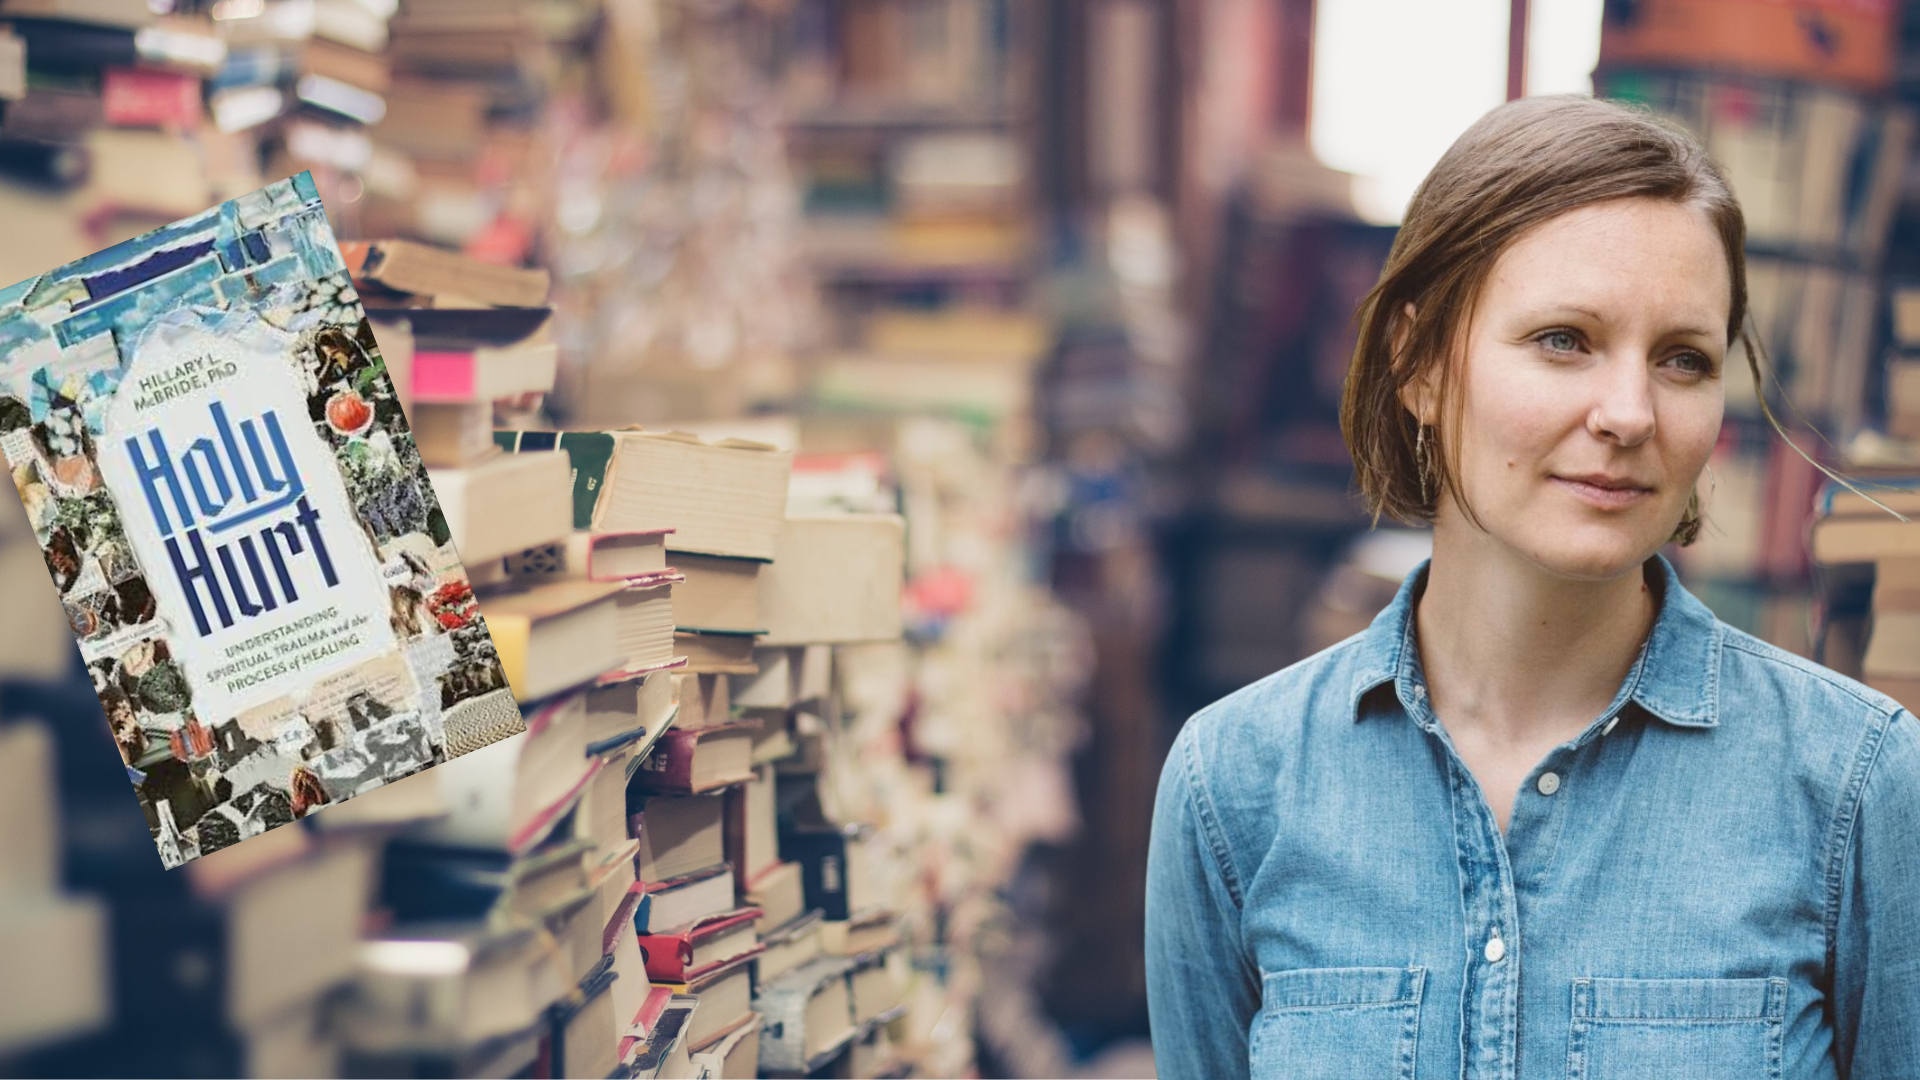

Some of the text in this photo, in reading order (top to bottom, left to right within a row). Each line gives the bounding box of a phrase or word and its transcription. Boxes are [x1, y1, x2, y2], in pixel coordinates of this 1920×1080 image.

[133, 362, 237, 411] McBRIDE, PhD
[139, 357, 204, 391] HILLARY
[125, 401, 305, 537] Holy
[164, 495, 340, 638] Hurt
[206, 614, 369, 682] SPIRITUAL TRAUMA and the
[225, 606, 338, 658] UNDERSTANDING
[227, 661, 287, 693] PROCESS
[289, 658, 301, 672] of
[302, 633, 360, 664] HEALING
